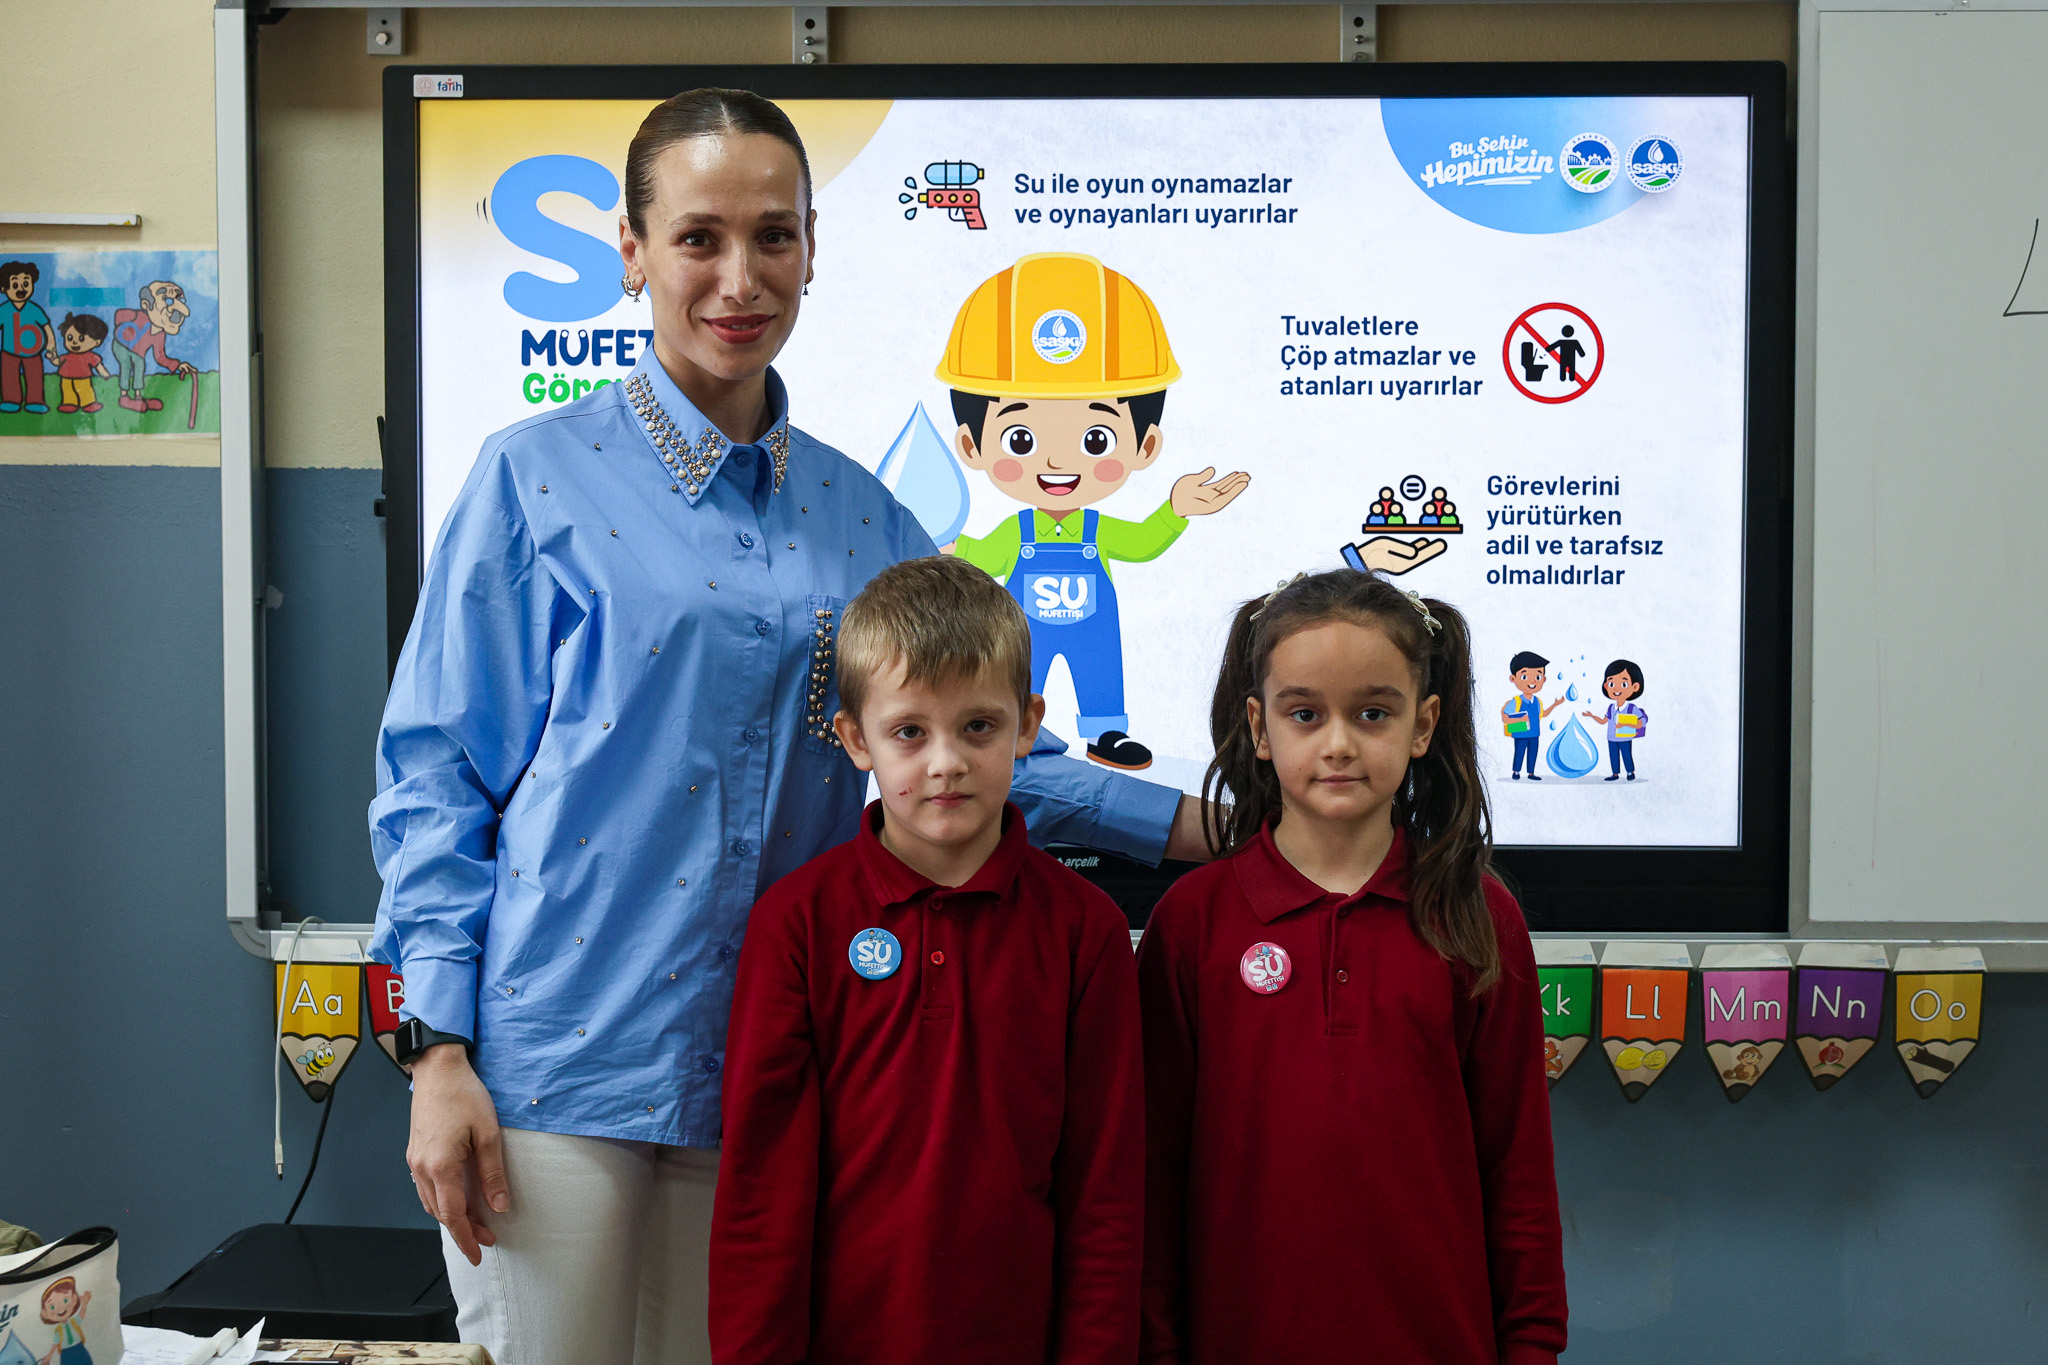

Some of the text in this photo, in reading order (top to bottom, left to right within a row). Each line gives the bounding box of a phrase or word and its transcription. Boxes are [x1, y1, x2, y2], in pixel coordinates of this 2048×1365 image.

[437, 78, 462, 91] fatih
[1449, 134, 1529, 158] Bu Şehir
[1420, 149, 1554, 188] Hepimizin
[1014, 173, 1292, 198] Su ile oyun oynamazlar
[1014, 203, 1298, 229] ve oynayanları uyarırlar
[1281, 315, 1419, 336] Tuvaletlere
[1281, 345, 1476, 370] Çöp atmazlar ve
[1280, 375, 1483, 401] atanları uyarırlar
[1487, 475, 1620, 496] Görevlerini
[1486, 505, 1622, 531] yürütürken
[1486, 534, 1663, 555] adil ve tarafsız
[1486, 564, 1626, 585] olmalıdırlar
[1033, 576, 1088, 610] SU
[1064, 856, 1100, 869] arçelik
[857, 941, 892, 964] SU
[1248, 954, 1284, 982] SU
